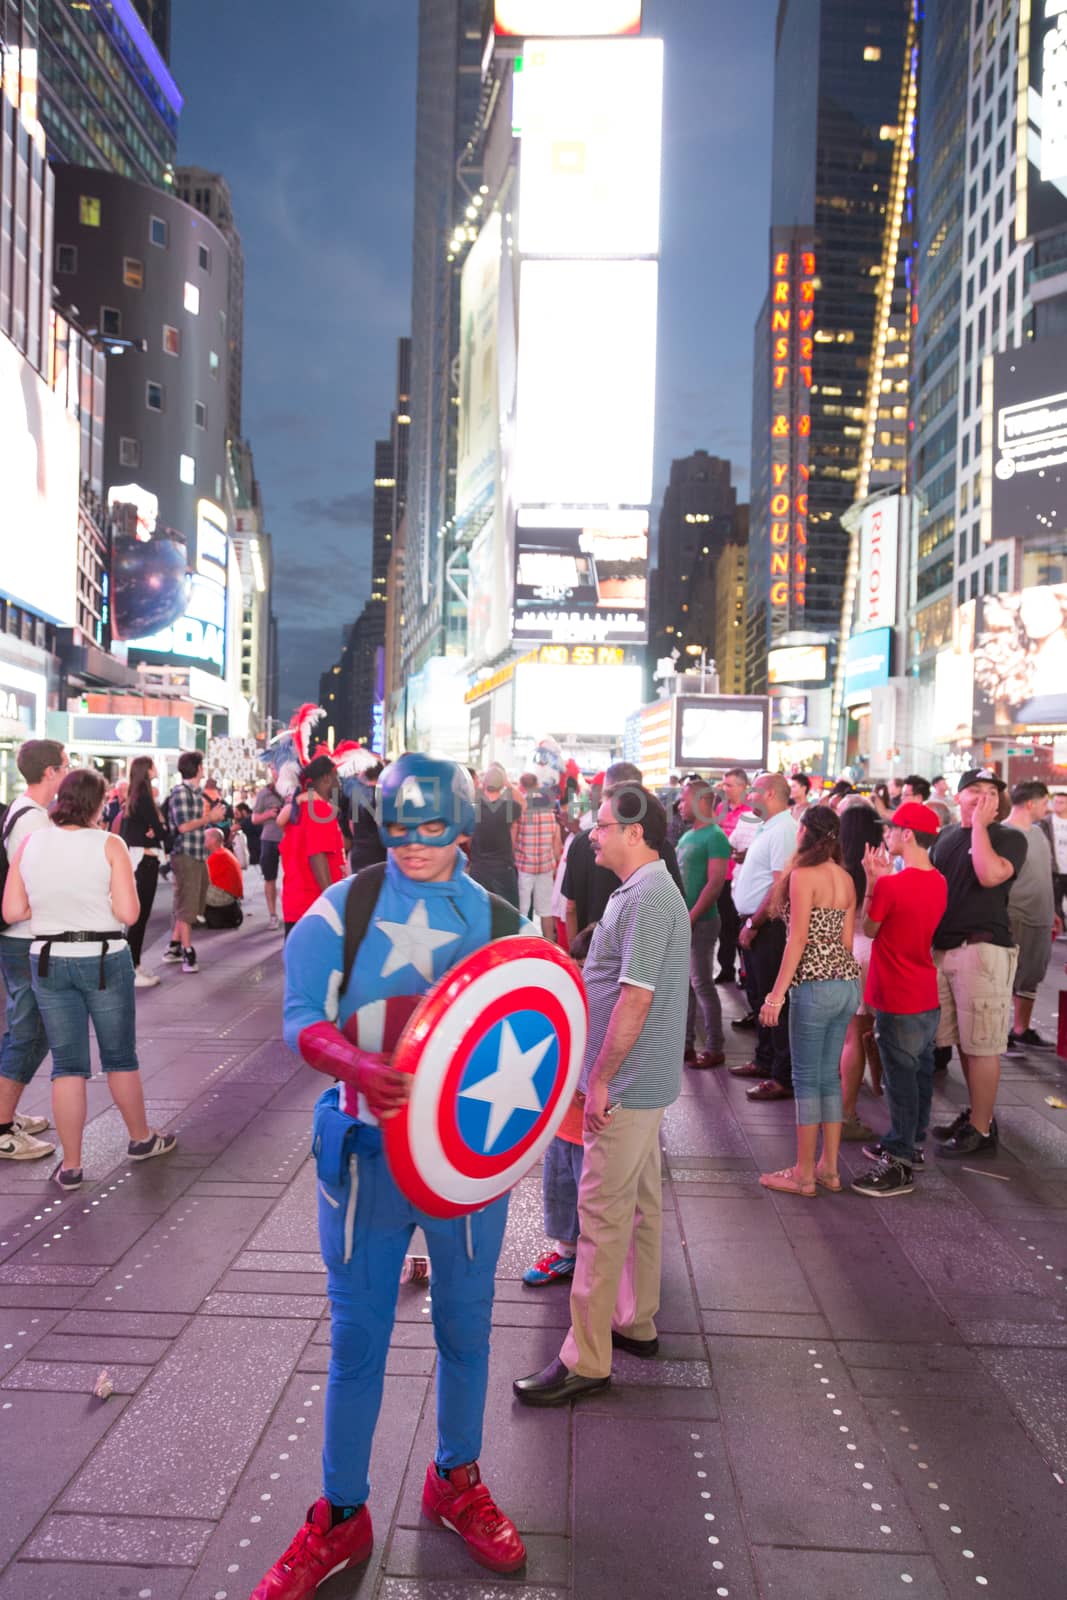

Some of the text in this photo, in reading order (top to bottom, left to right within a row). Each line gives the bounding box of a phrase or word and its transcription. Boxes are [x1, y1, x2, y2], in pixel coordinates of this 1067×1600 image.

[770, 253, 791, 605] ERNST & YOUNG
[394, 775, 426, 808] A
